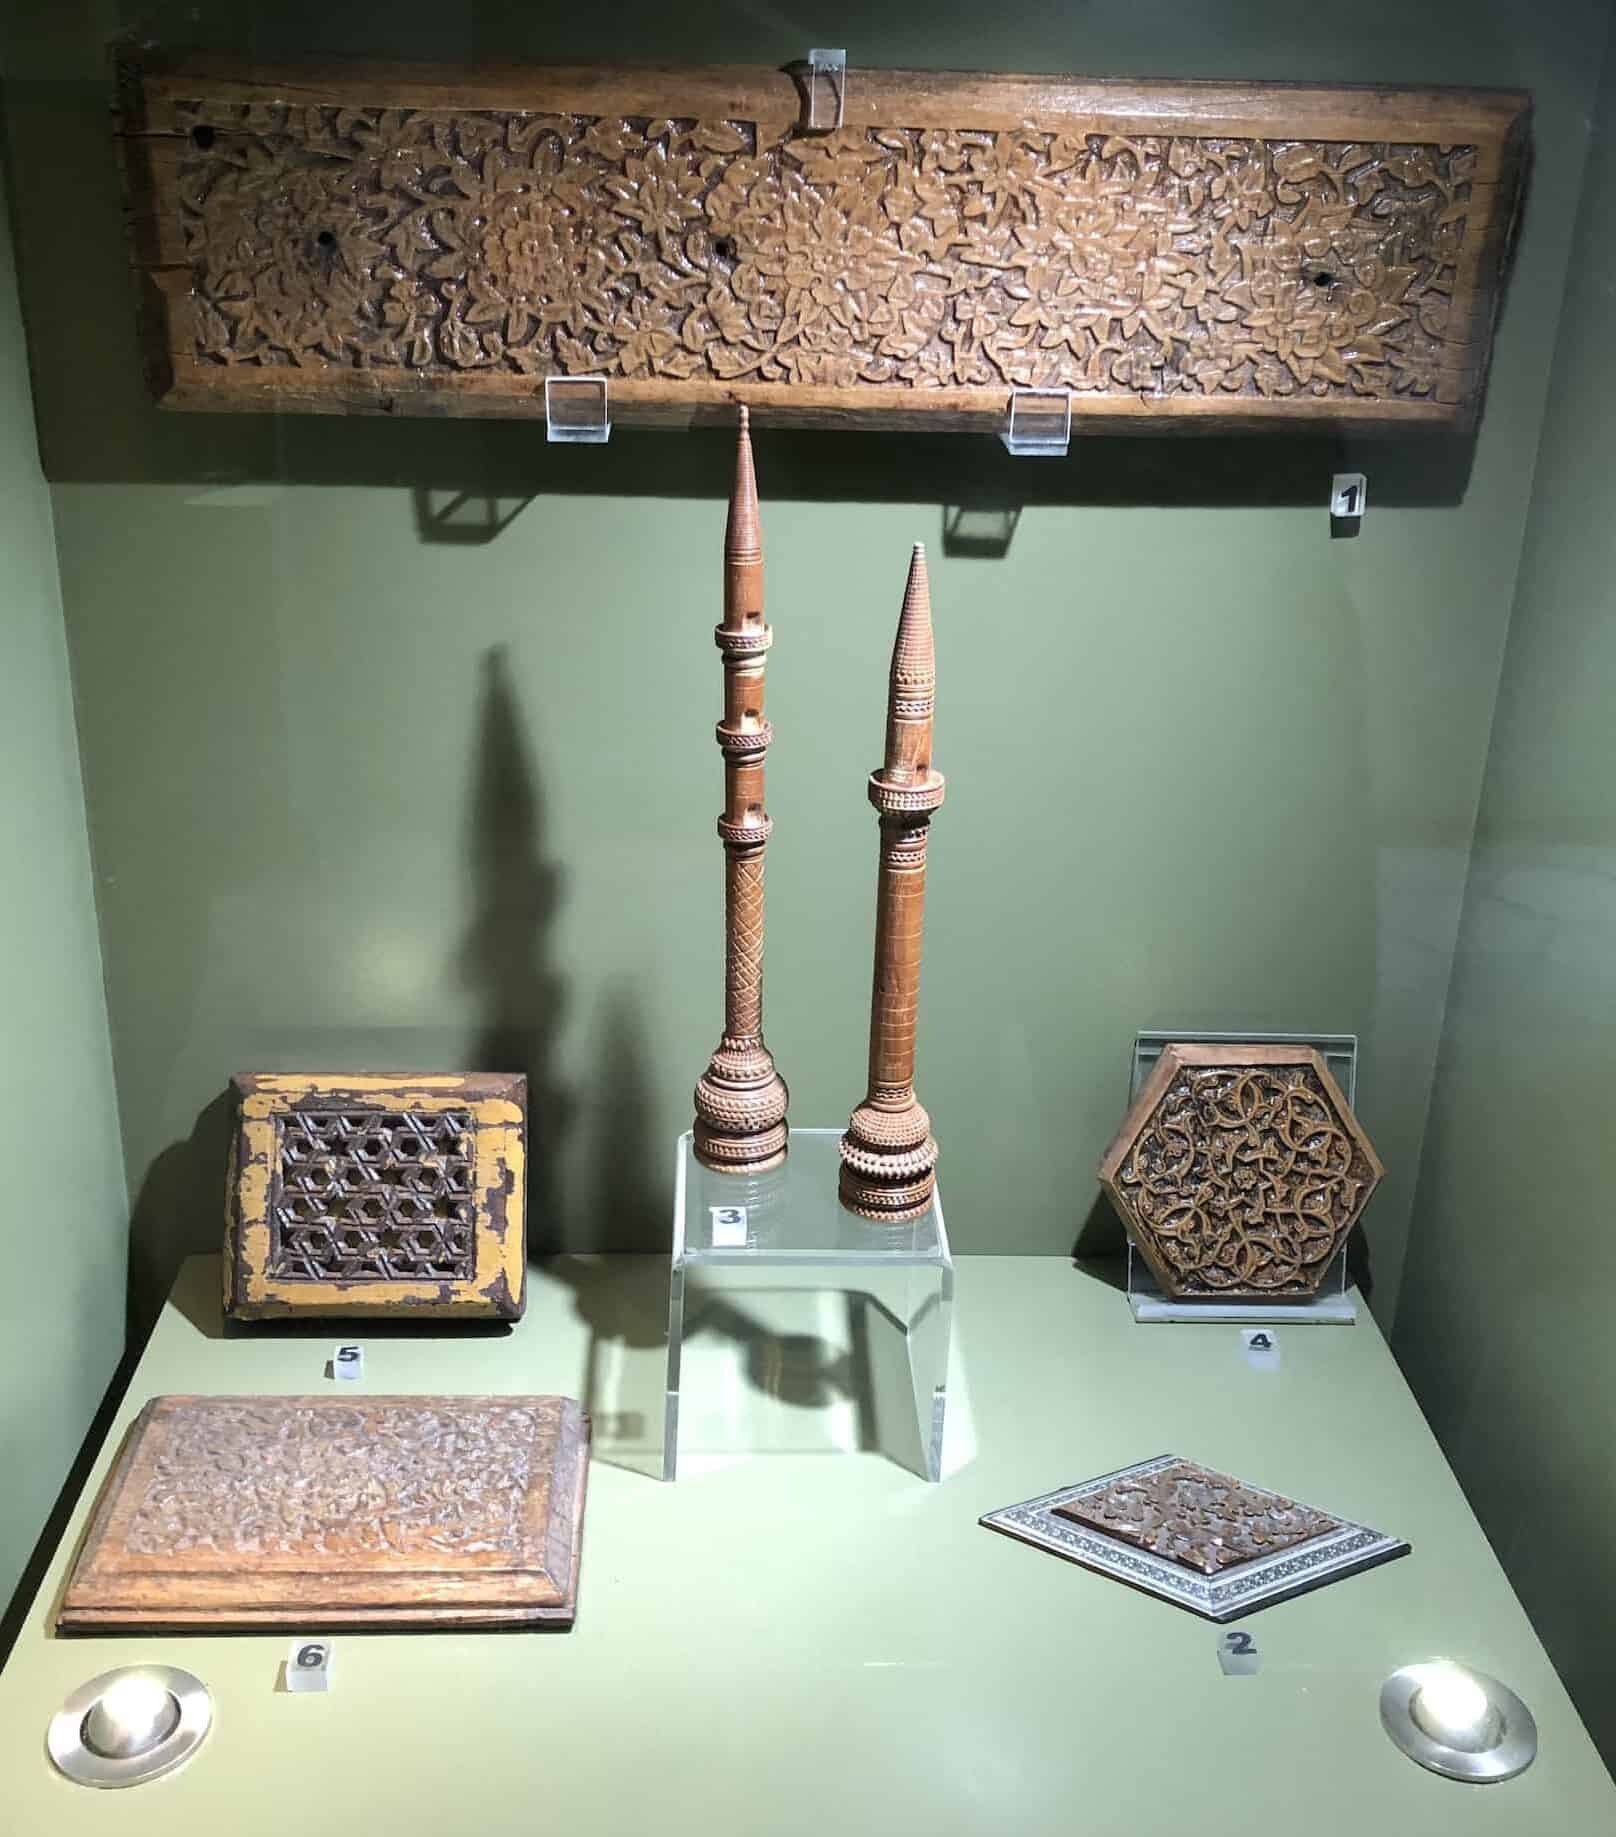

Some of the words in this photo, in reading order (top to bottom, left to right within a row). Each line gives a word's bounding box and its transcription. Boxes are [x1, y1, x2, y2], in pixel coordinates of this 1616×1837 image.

[1340, 485, 1359, 513] 1
[718, 1209, 742, 1224] 3
[1250, 1333, 1272, 1349] 4
[337, 1346, 360, 1362] 5
[1226, 1632, 1257, 1656] 2
[297, 1644, 324, 1668] 6
